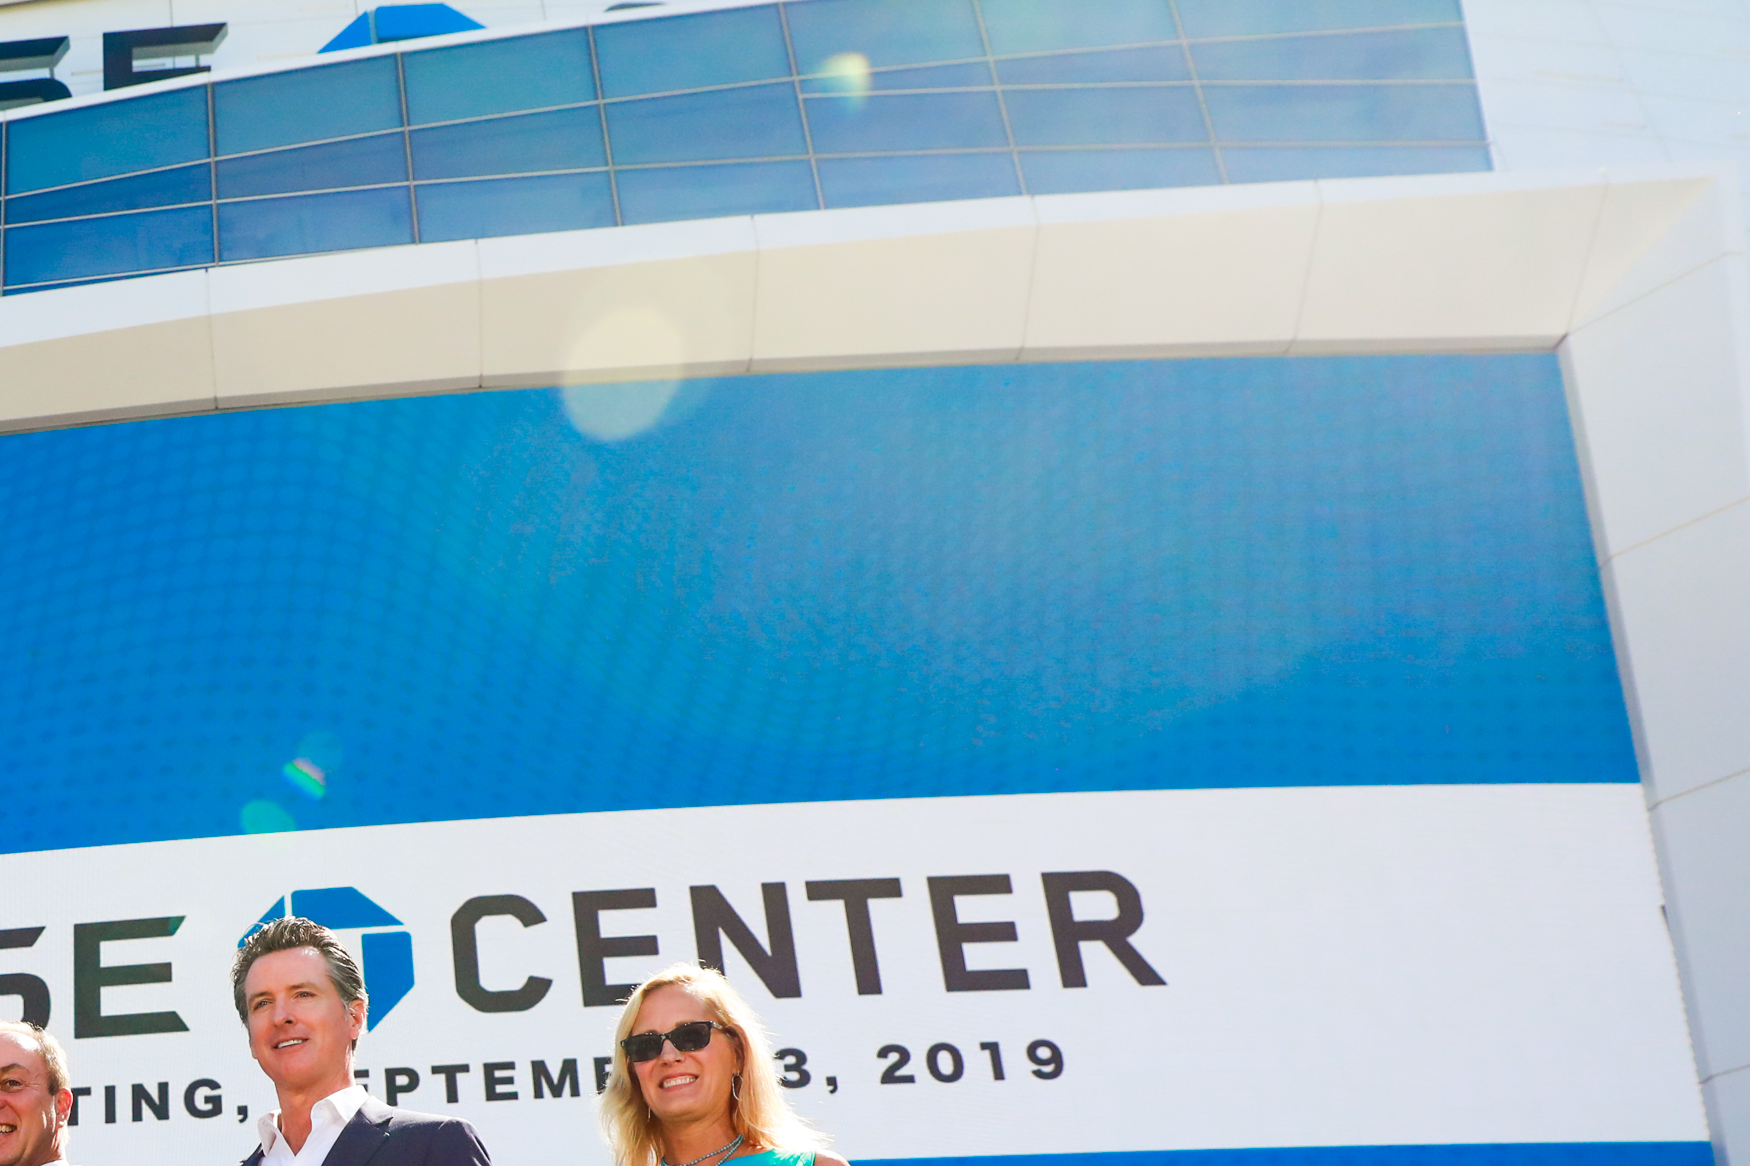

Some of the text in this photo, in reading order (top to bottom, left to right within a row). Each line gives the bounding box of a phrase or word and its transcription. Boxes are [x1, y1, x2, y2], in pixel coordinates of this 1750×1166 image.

[450, 870, 1167, 1013] CENTER
[773, 1038, 1064, 1095] 3, 2019
